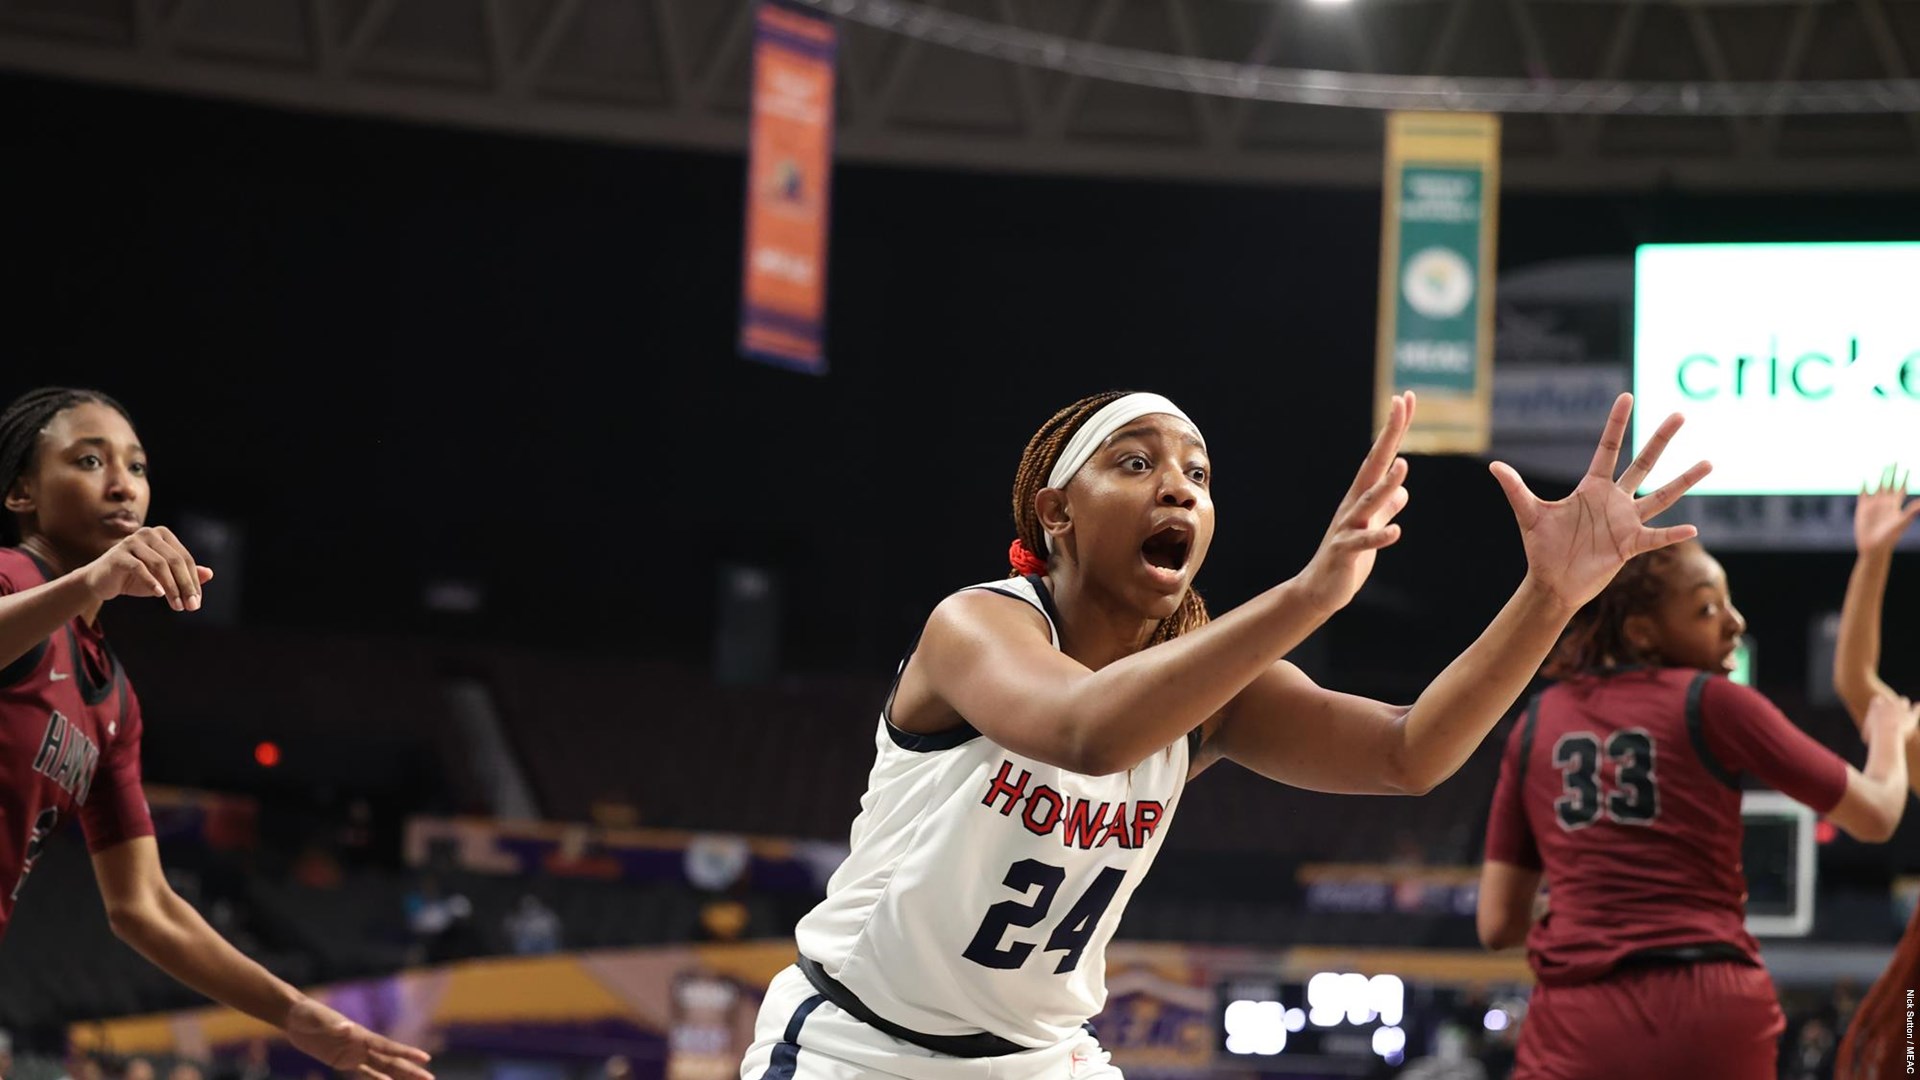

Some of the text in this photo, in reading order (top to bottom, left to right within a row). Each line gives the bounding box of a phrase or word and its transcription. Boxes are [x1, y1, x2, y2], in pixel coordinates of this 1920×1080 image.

[1675, 334, 1920, 400] cric
[980, 759, 1172, 850] HOWAR
[1552, 726, 1661, 833] 33
[961, 858, 1127, 975] 24
